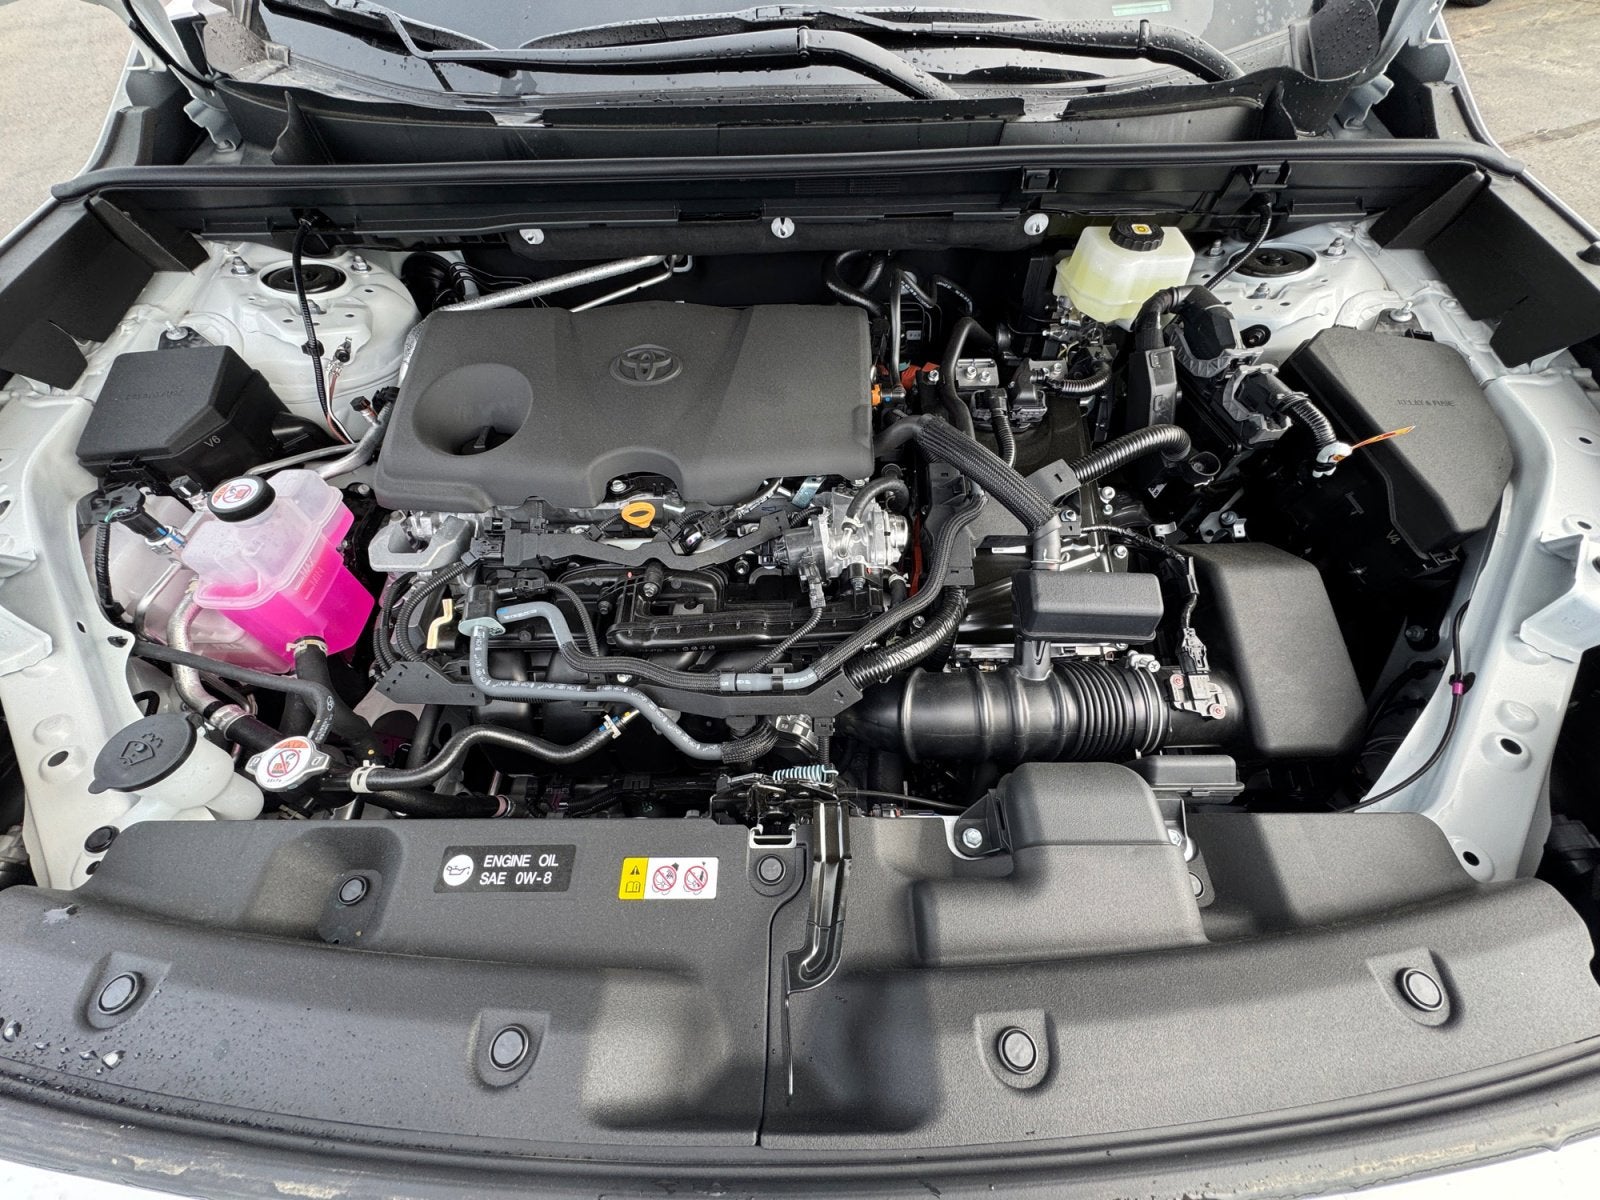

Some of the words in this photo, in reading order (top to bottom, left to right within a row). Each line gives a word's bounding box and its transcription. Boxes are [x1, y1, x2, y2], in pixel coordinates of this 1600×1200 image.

[203, 435, 221, 447] V6
[1386, 530, 1401, 545] V4
[483, 854, 532, 868] ENGINE
[538, 853, 559, 867] OIL
[479, 871, 507, 885] SAE
[515, 871, 552, 885] 0W-8
